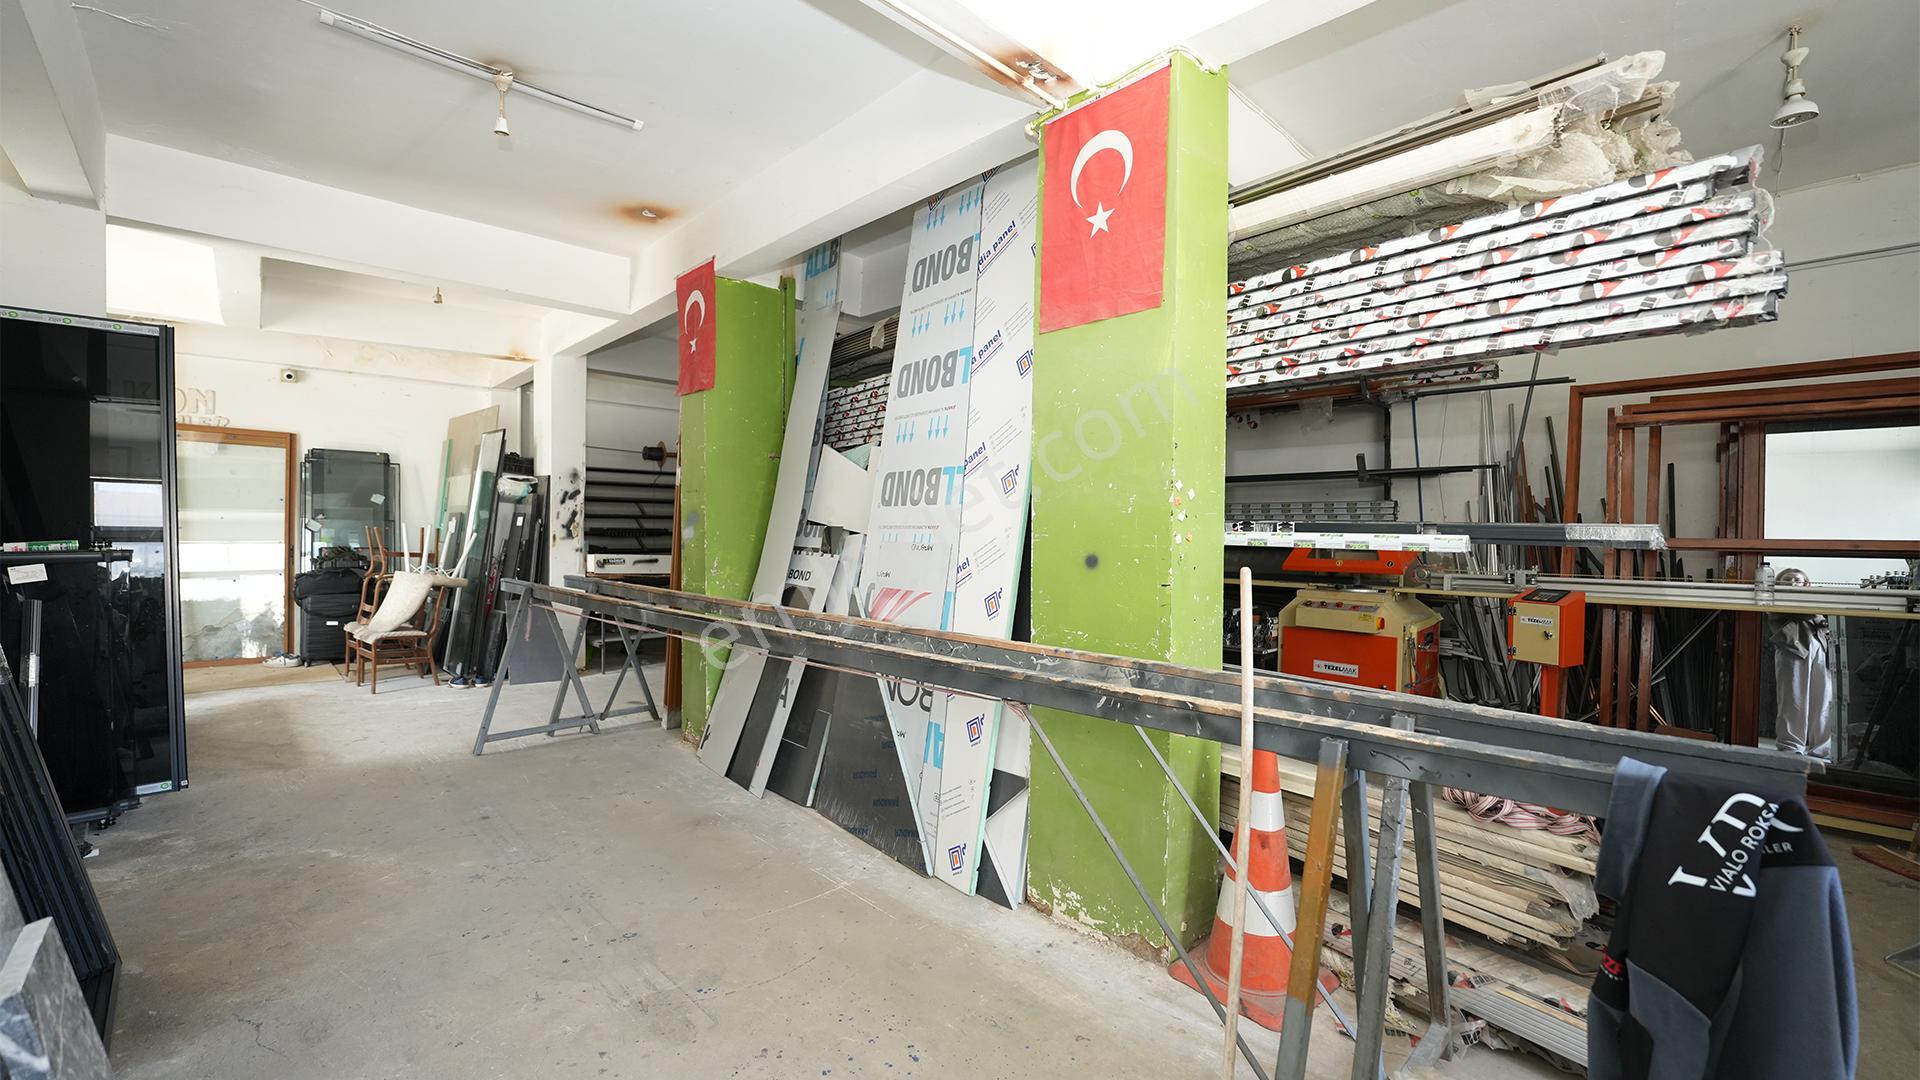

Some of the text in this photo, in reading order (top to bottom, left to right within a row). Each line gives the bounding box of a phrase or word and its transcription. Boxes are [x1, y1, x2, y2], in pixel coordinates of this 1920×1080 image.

[992, 220, 1016, 252] panel
[977, 329, 1002, 360] panel
[1762, 841, 1793, 855] LER
[1709, 848, 1749, 892] VIALO
